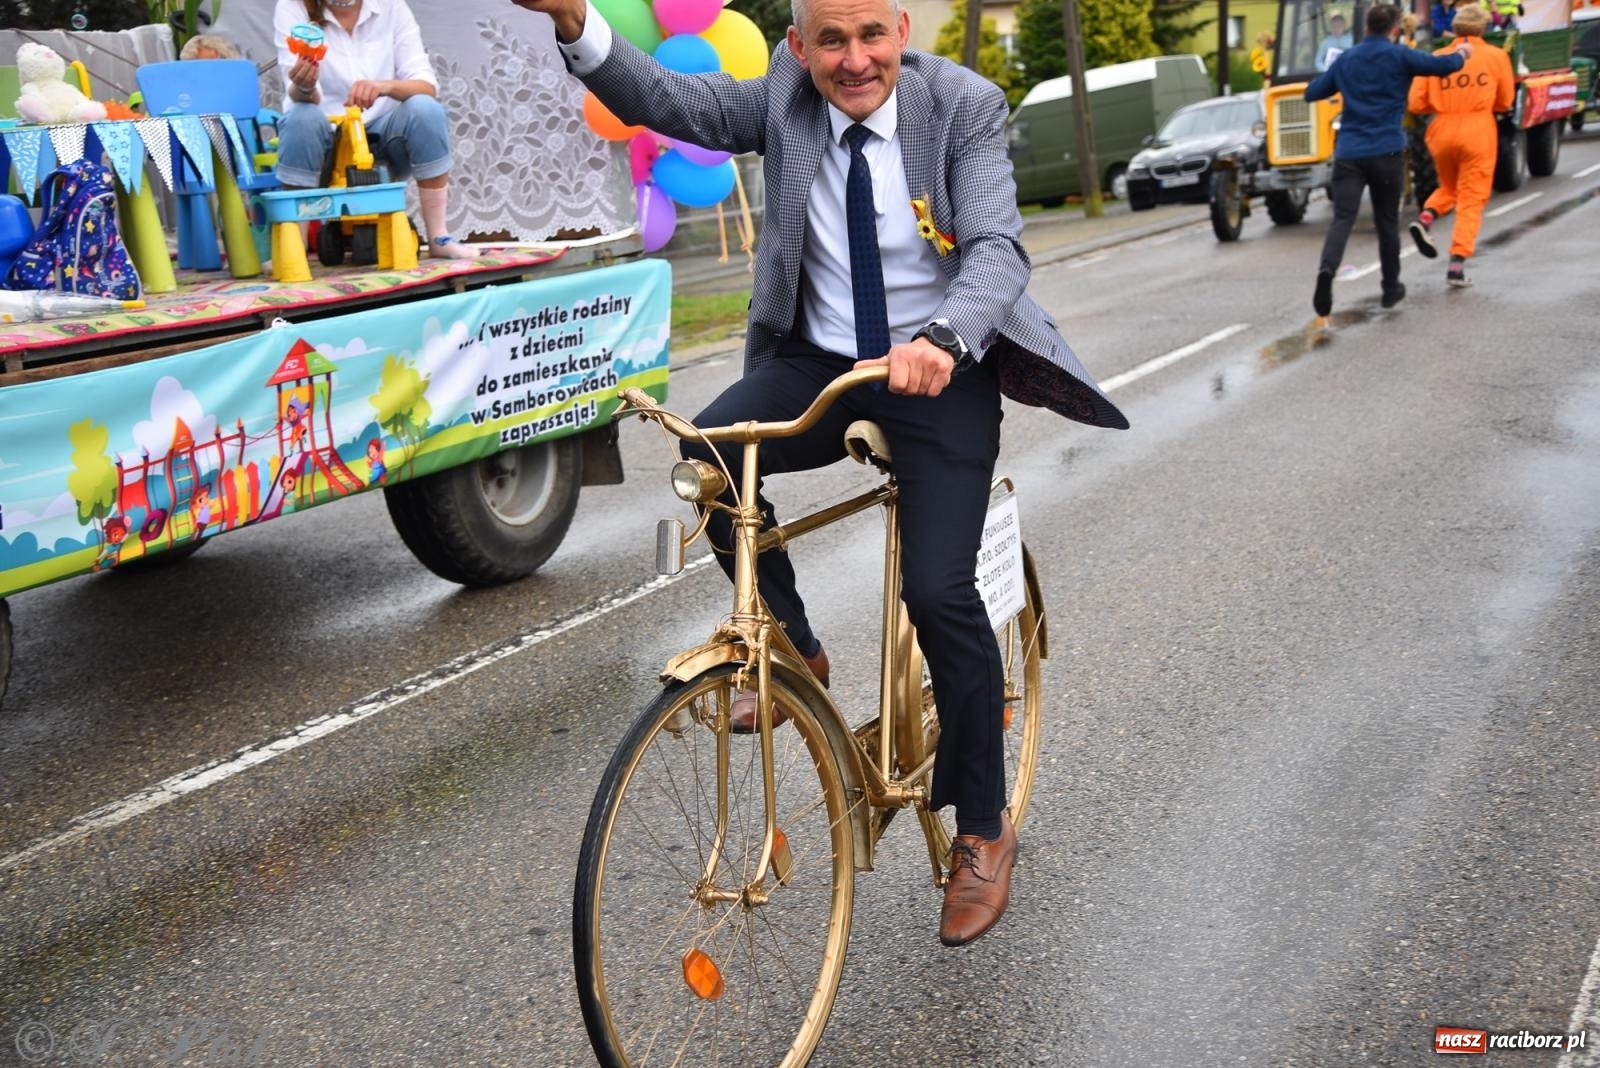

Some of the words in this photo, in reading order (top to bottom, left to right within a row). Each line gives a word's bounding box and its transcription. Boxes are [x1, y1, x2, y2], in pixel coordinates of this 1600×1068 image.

[489, 306, 568, 338] wszystkie
[573, 296, 632, 321] rodziny
[510, 346, 518, 360] z
[522, 328, 584, 358] dziećmi
[476, 375, 498, 396] do
[471, 409, 487, 425] w
[501, 399, 597, 444] zapraszają!
